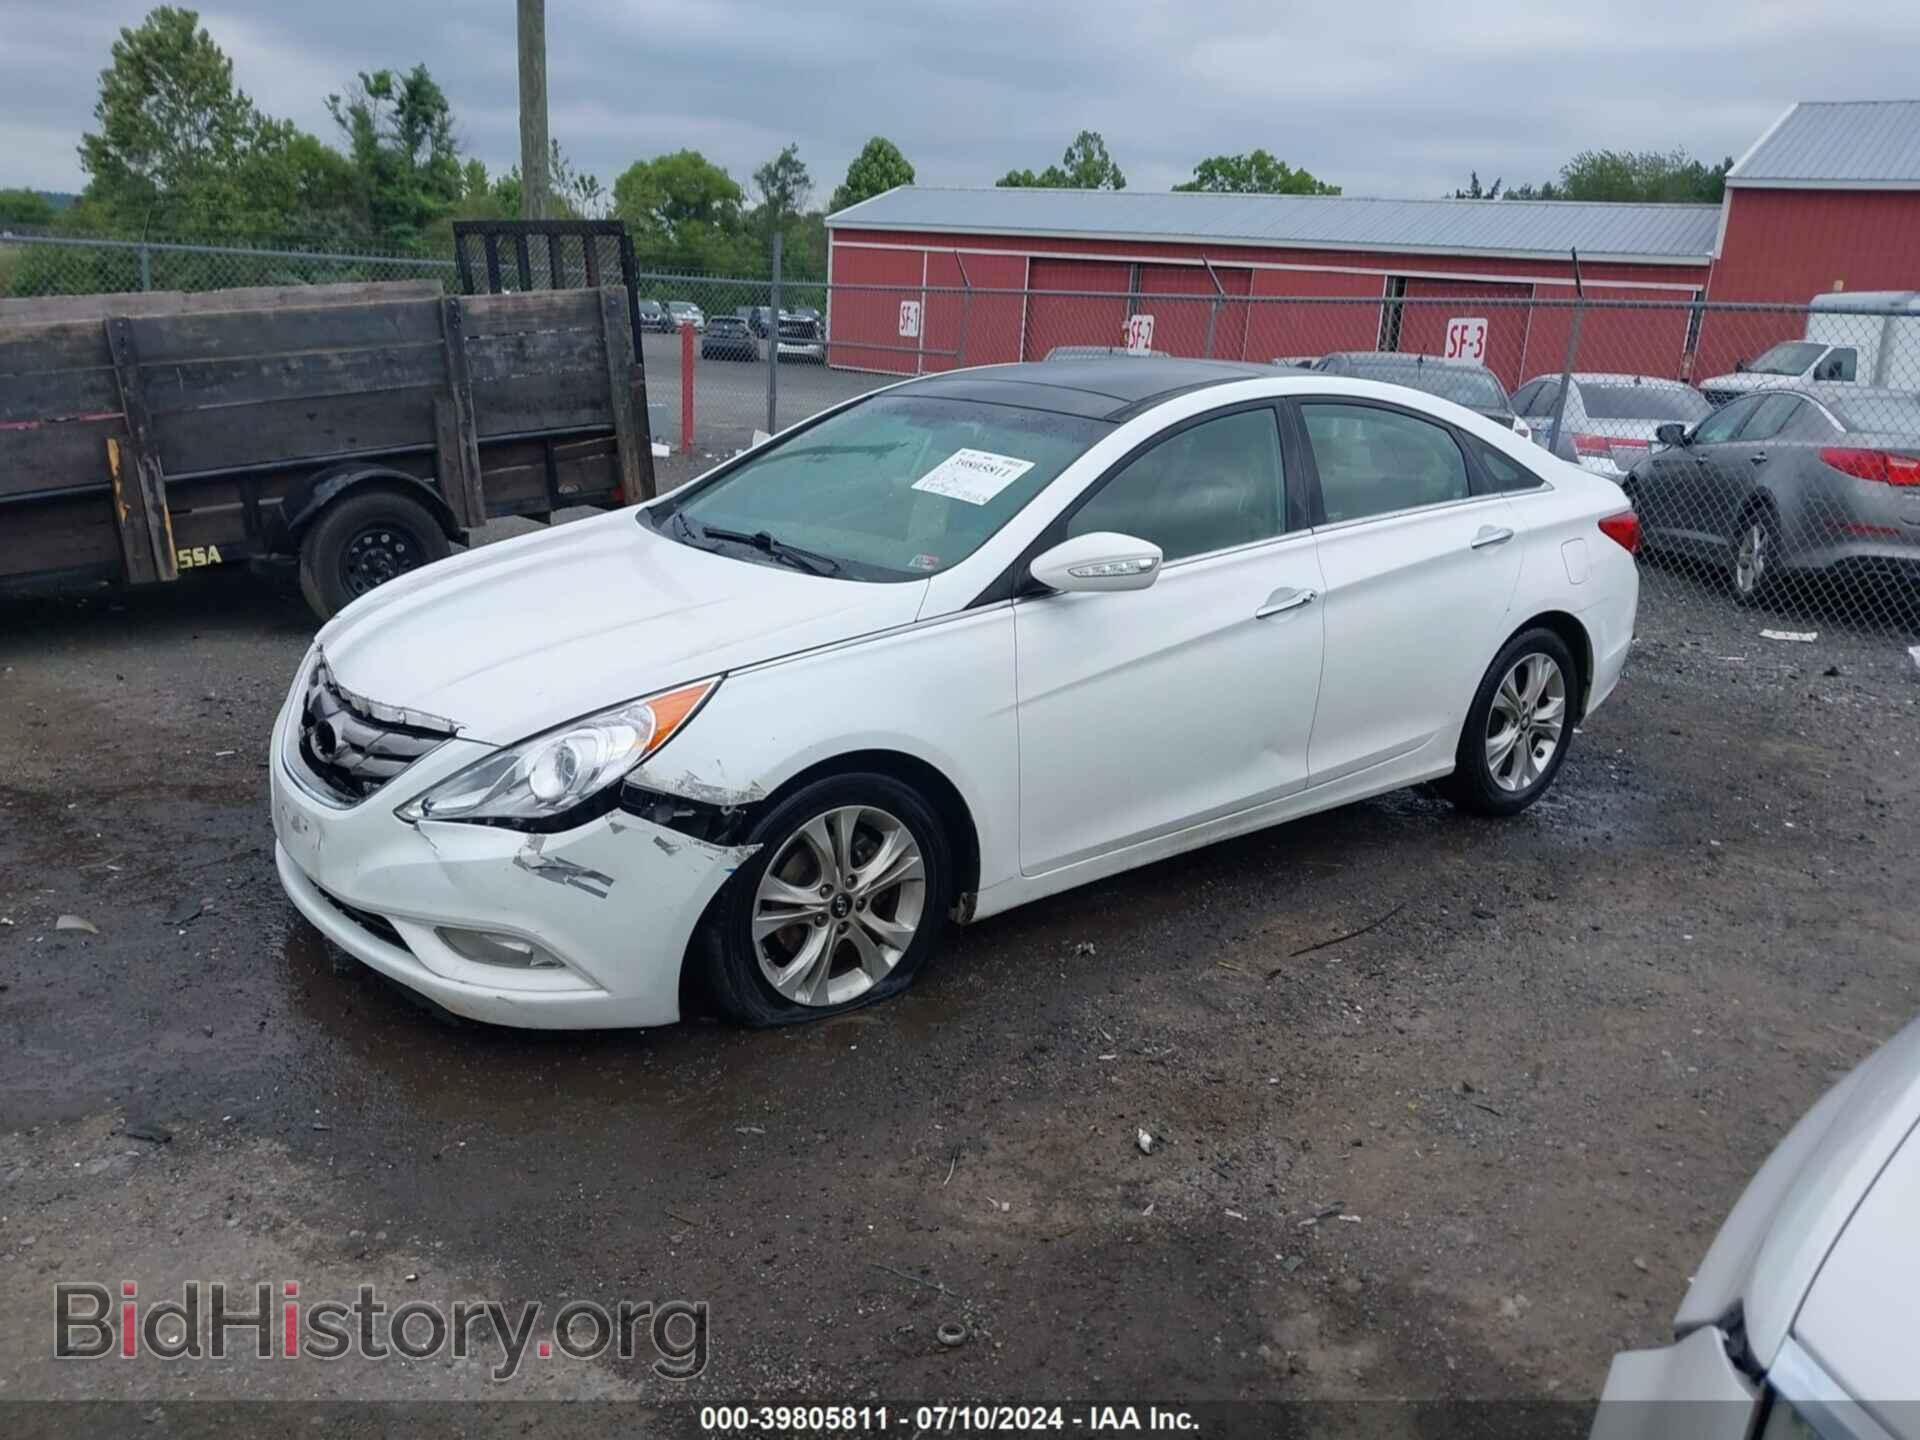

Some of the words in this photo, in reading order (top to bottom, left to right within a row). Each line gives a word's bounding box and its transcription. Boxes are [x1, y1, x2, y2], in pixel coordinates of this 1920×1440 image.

[902, 305, 919, 331] SF-1
[1130, 320, 1152, 349] SF-2
[1448, 324, 1484, 358] SF-3
